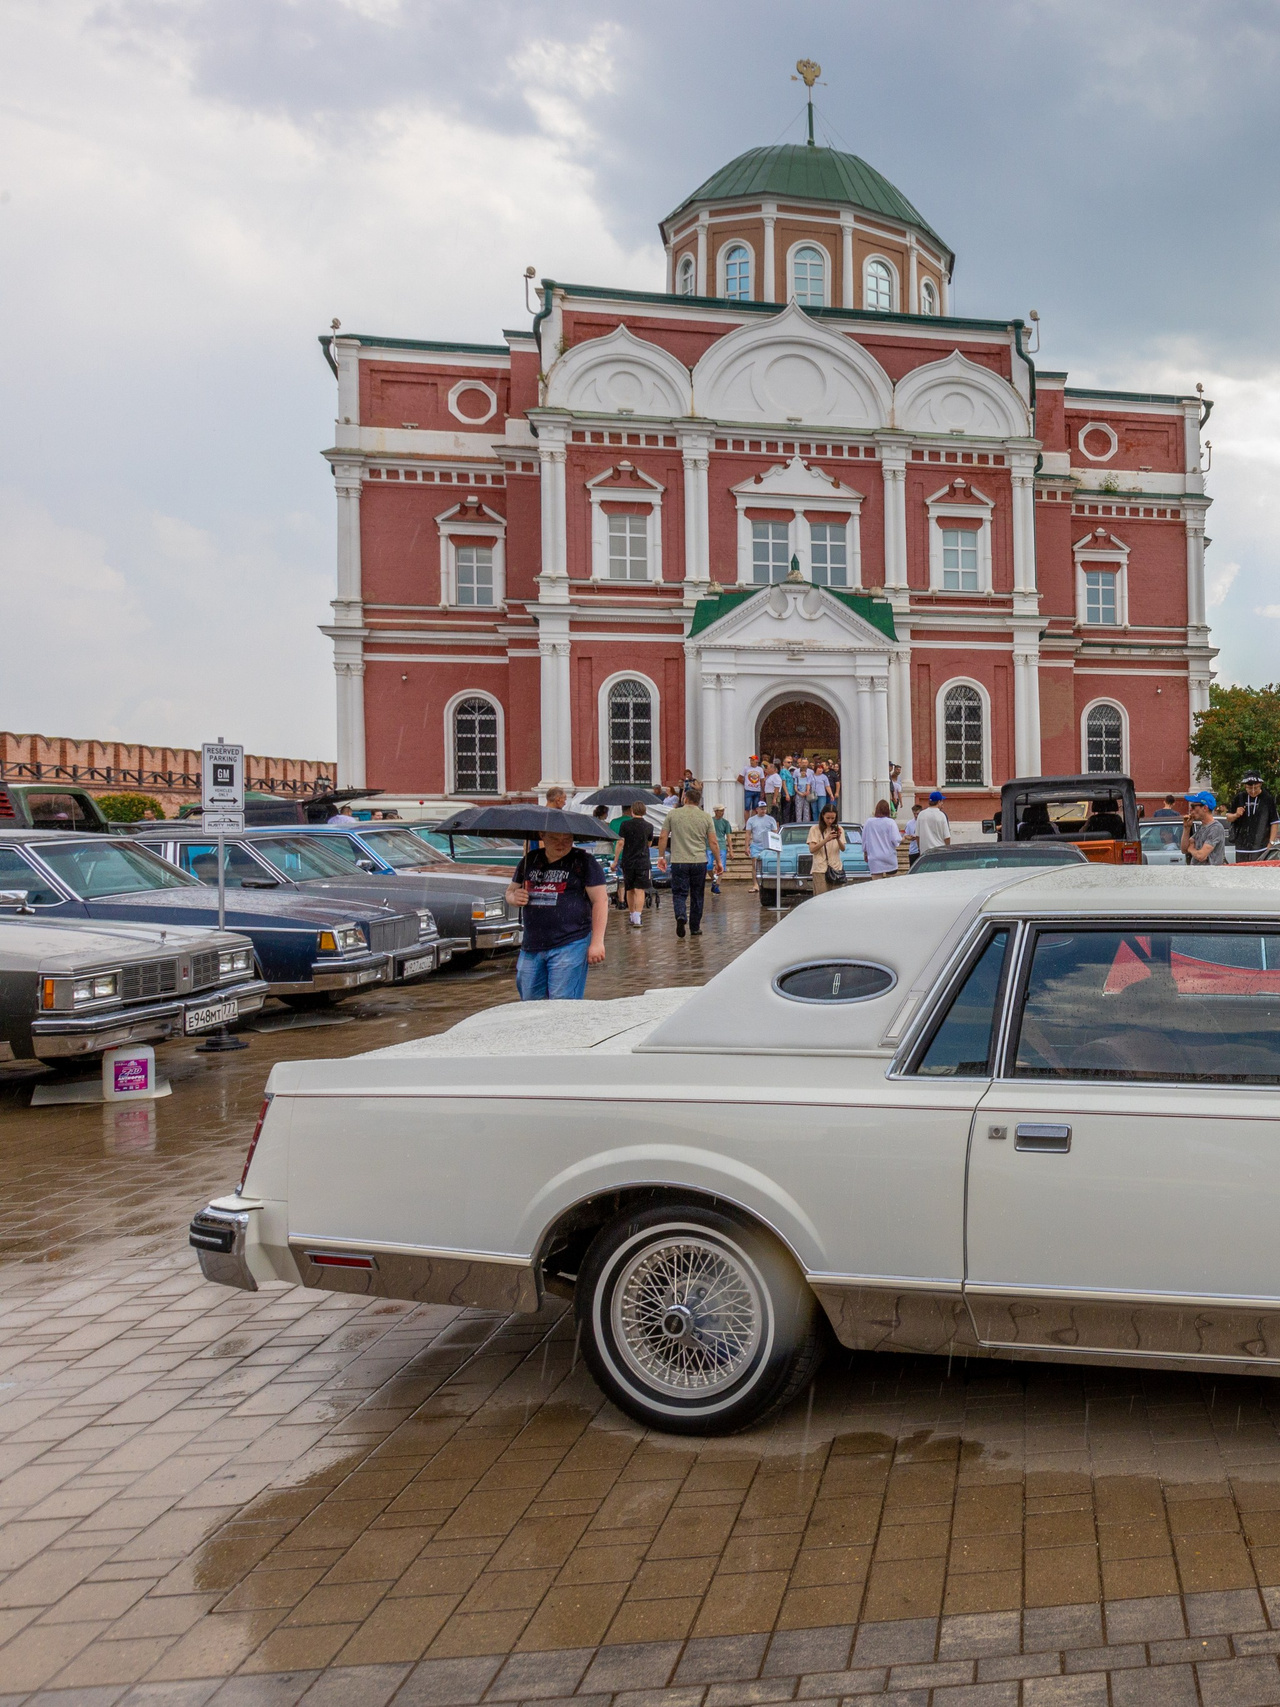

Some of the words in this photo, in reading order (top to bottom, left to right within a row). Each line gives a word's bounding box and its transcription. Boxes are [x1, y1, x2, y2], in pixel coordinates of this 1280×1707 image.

[207, 747, 240, 756] RESERVED
[217, 769, 230, 779] GM
[222, 1002, 235, 1015] 777
